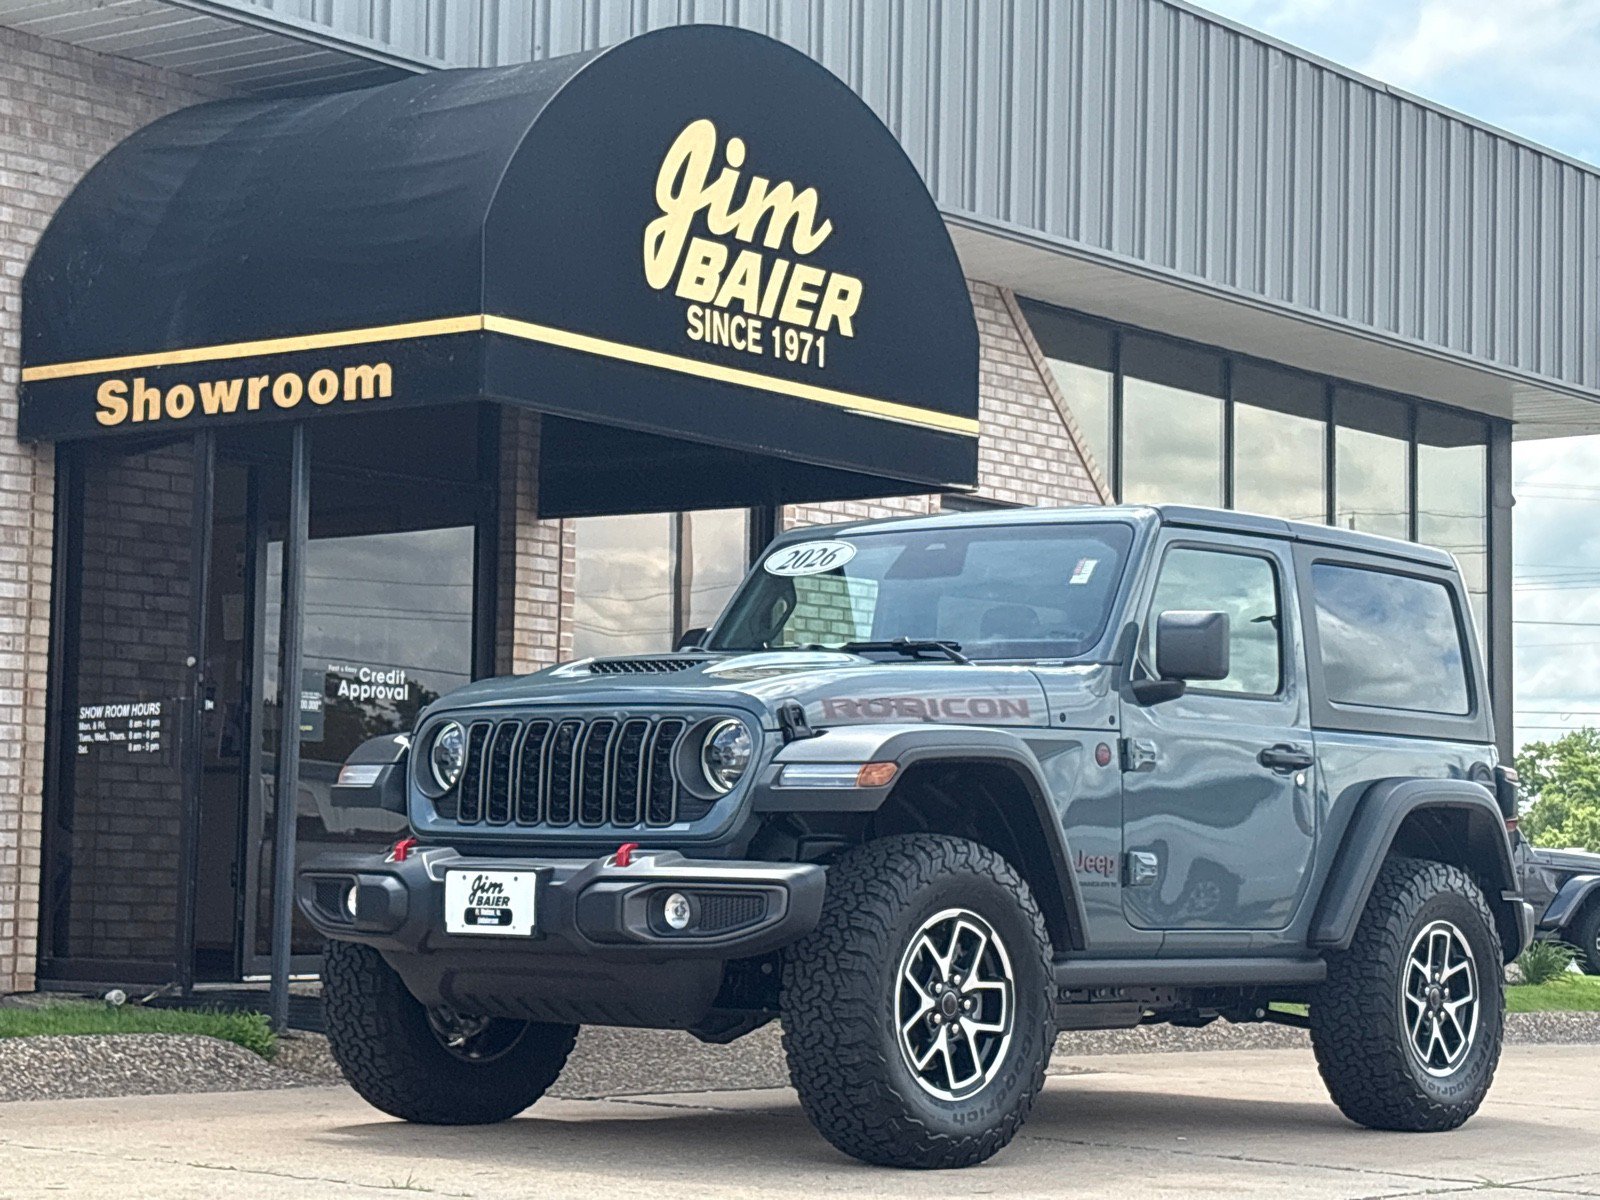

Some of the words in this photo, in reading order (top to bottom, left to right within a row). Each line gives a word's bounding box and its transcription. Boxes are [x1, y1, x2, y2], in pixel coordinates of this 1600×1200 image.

[644, 118, 833, 290] Jim
[675, 237, 863, 338] BAIER
[686, 305, 763, 355] SINCE
[771, 326, 826, 368] 1971
[95, 362, 393, 427] Showroom
[775, 546, 845, 571] 2026
[359, 667, 406, 685] Credit
[337, 679, 409, 701] Approval
[79, 705, 104, 719] SHOW
[104, 704, 130, 718] ROOM
[130, 702, 161, 717] HOURS
[821, 697, 1030, 720] RUBICON
[1074, 850, 1115, 878] Jeep
[468, 874, 504, 905] Jim
[476, 895, 511, 907] BAIER
